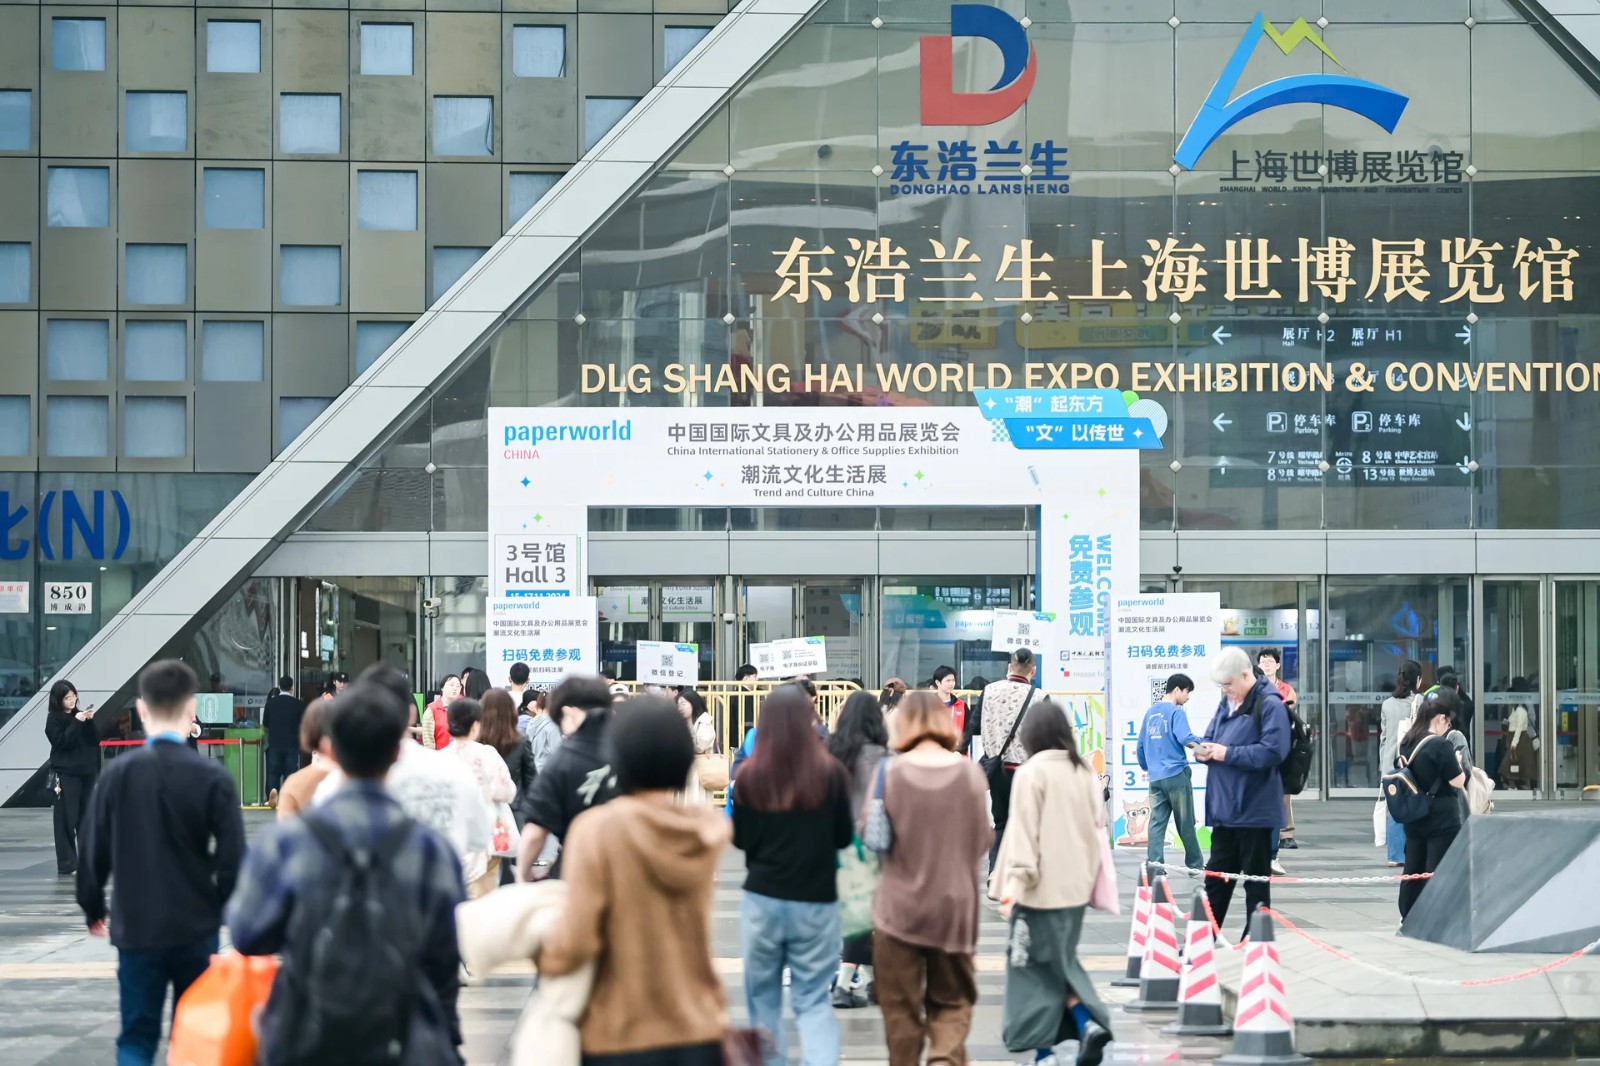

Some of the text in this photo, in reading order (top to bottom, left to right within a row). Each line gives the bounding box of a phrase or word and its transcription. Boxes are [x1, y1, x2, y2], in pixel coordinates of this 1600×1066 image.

[890, 140, 1070, 182] 东浩兰生
[1219, 150, 1464, 183] 上海世博展览馆
[890, 184, 1070, 195] DONGHAO LANSHENG
[770, 236, 1580, 304] 东浩兰生上海世博展览馆
[1282, 327, 1310, 340] 展厅
[1352, 327, 1402, 341] 展厅 H1
[581, 363, 651, 394] DLG
[663, 363, 791, 394] SHANG
[804, 363, 863, 394] HAI
[875, 363, 1012, 394] WORLD
[1025, 363, 1120, 393] EXPO
[1132, 362, 1332, 393] EXHIBITION
[1345, 362, 1375, 392] &
[1050, 395, 1104, 413] 起东方
[1294, 414, 1336, 427] 停车库
[1378, 413, 1421, 427] 停车库
[504, 419, 631, 446] paperworld
[668, 422, 960, 443] 中国国际文具及办公用品展览会
[1072, 424, 1125, 442] 以传世
[503, 449, 540, 460] CHINA
[667, 446, 959, 457] China International Stationery & Office Supplies Exhibition
[1268, 451, 1276, 463] 7
[1362, 450, 1371, 464] 8
[741, 464, 887, 484] 潮流文化生活展
[1267, 469, 1276, 481] 8
[1363, 468, 1378, 481] 13
[753, 488, 874, 497] Trend and Culture China
[506, 542, 566, 563] 3号馆
[506, 565, 566, 583] Hall 3
[50, 585, 87, 600] 850
[1069, 534, 1094, 637] 免费参观
[493, 601, 540, 611] paperworld
[641, 596, 703, 605] 潮文化生活展
[1117, 598, 1165, 607] paperworld
[1118, 615, 1213, 624] 中国国际文具及办公用品展览会
[502, 649, 581, 662] 扫码免费参观
[1128, 645, 1206, 658] 扫码免费参观
[1127, 721, 1137, 736] 1
[1125, 771, 1136, 786] 3
